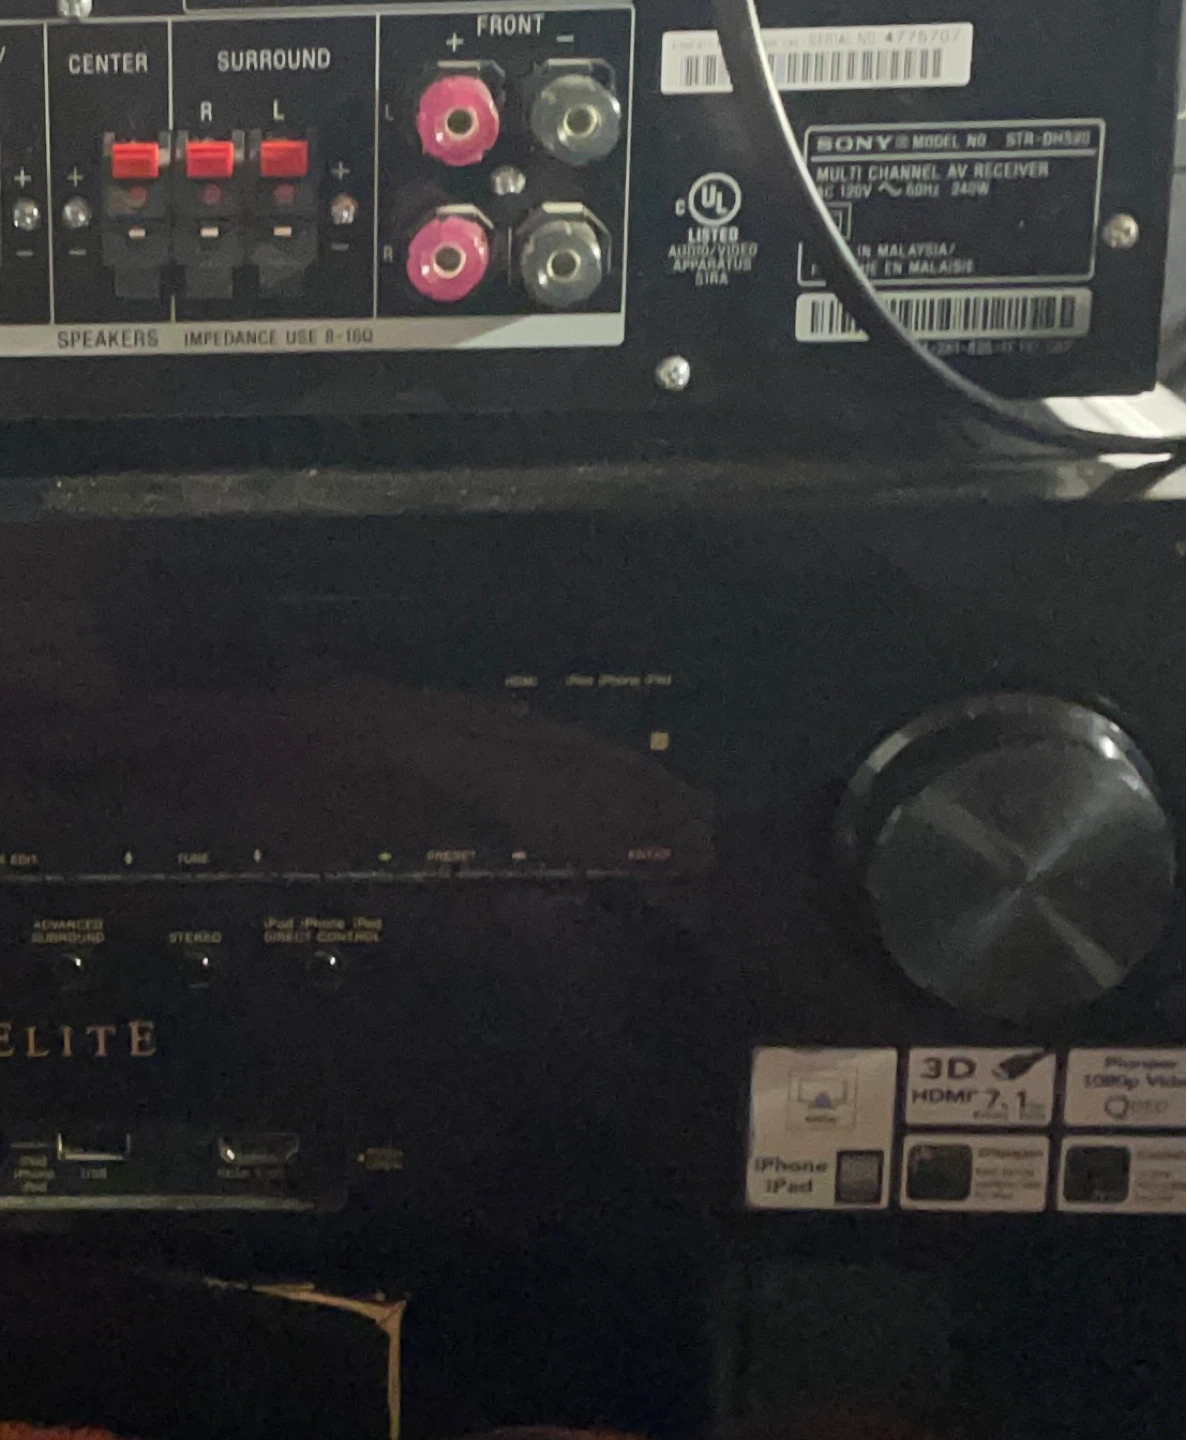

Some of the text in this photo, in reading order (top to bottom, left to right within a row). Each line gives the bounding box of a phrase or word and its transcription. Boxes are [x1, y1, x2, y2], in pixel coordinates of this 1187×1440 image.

[476, 13, 546, 37] FRONT
[68, 52, 149, 75] CENTER
[216, 47, 331, 72] SURROUND
[200, 99, 213, 122] R
[272, 99, 285, 121] L
[384, 104, 394, 121] L
[816, 132, 960, 153] SONY MODEL
[816, 159, 1049, 183] MULTI CHANNEL AV RECEIVER
[700, 183, 730, 217] UL
[840, 183, 872, 200] 120V
[383, 244, 393, 262] R
[877, 240, 956, 259] MALAYSIA/
[884, 259, 903, 277] EN
[57, 329, 317, 350] SPEAKERS IMPEDANCE USE
[33, 918, 104, 932] ADVANCED
[30, 931, 105, 945] SURROUND
[169, 930, 223, 944] STEREO
[920, 1056, 977, 1081] 3D
[984, 1086, 1027, 1111] 7.1
